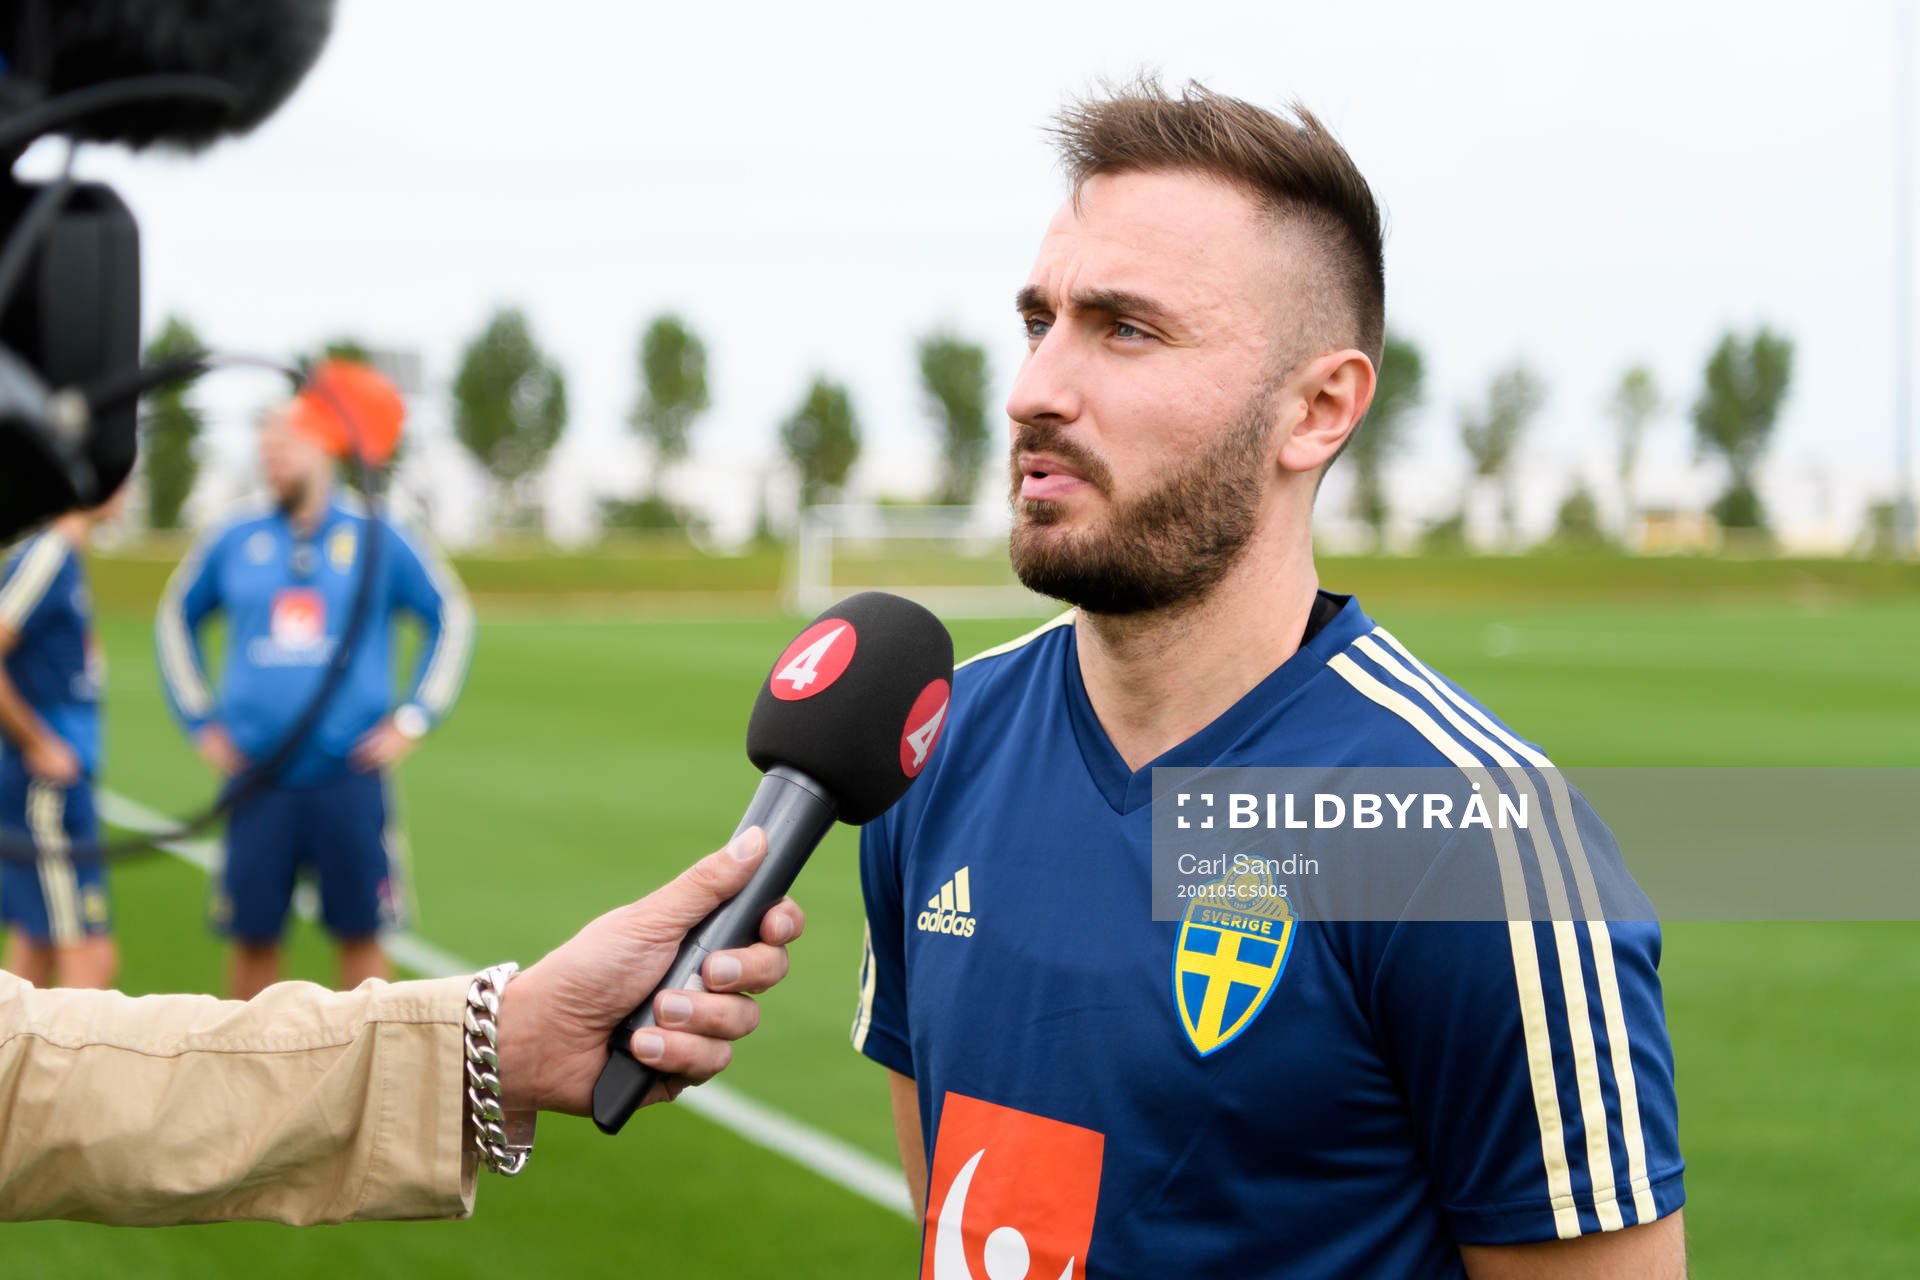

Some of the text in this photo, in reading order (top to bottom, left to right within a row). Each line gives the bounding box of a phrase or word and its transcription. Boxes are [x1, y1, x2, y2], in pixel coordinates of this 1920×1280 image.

[776, 624, 847, 690] 4
[906, 697, 949, 768] 4
[917, 907, 976, 937] adidas
[1201, 909, 1273, 935] SVERIGE
